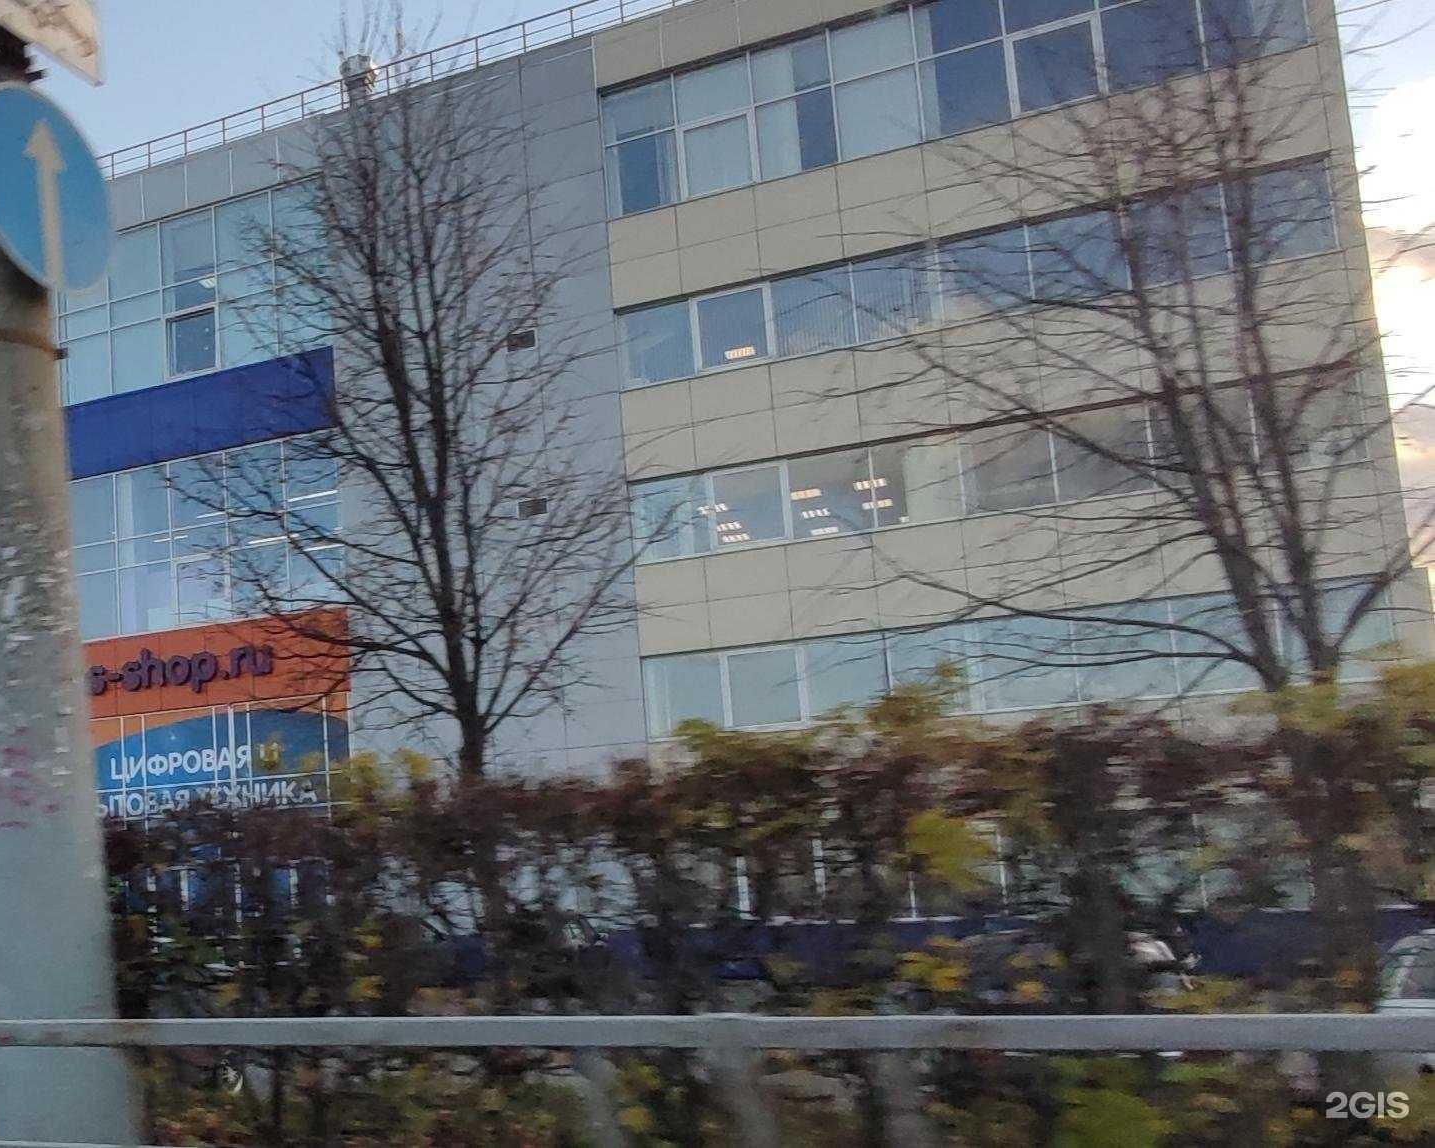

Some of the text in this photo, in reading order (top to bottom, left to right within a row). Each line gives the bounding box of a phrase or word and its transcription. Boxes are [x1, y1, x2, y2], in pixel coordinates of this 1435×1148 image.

[88, 643, 273, 696] s-shop.ru
[110, 744, 252, 783] ЦИФРОВАЯ
[95, 787, 191, 818] ЫТОВАЯ
